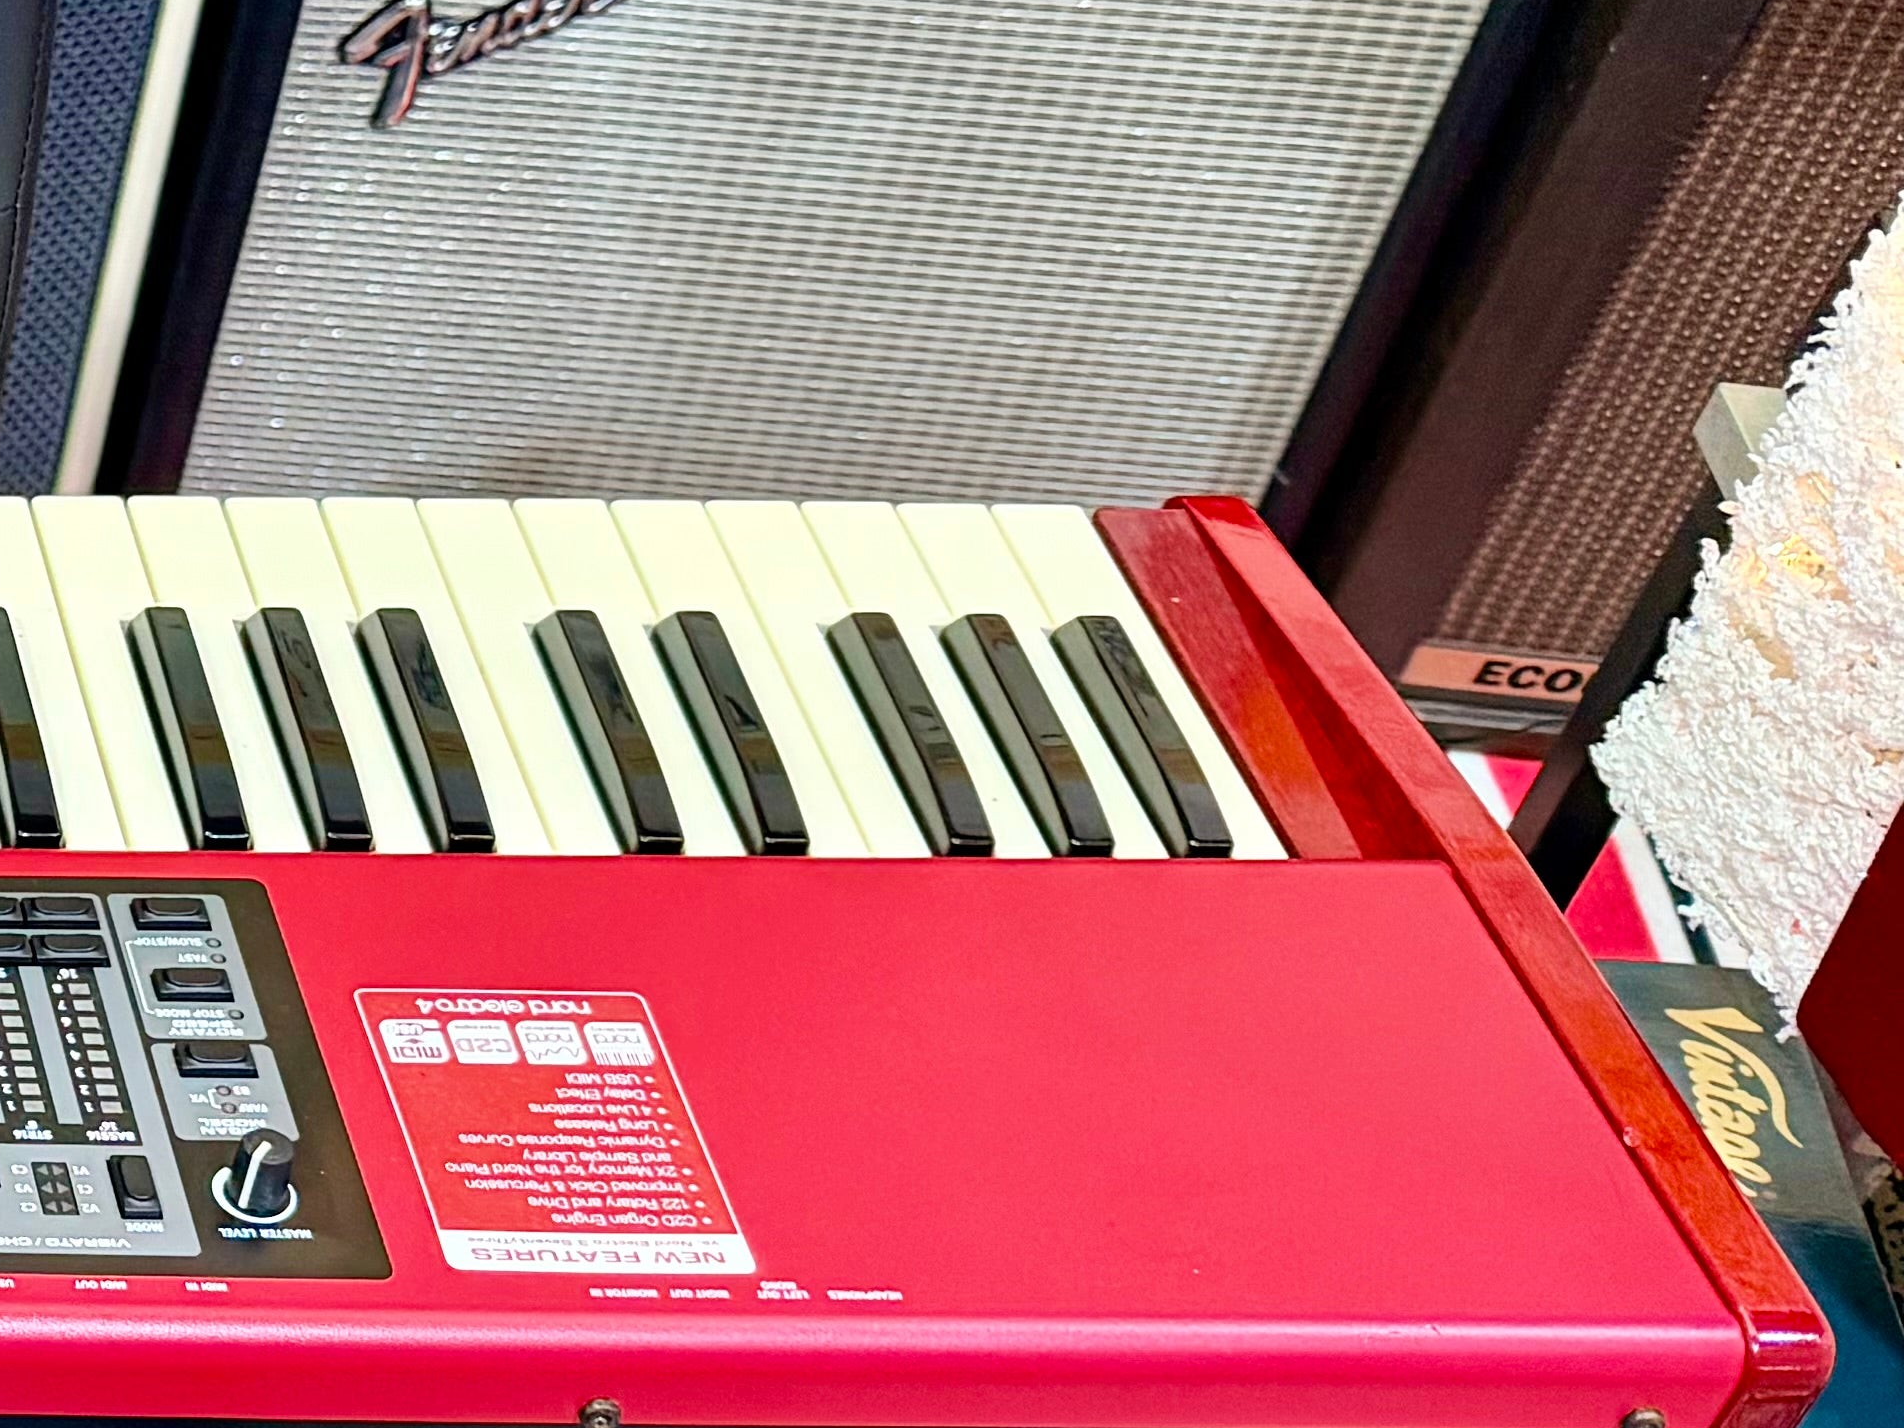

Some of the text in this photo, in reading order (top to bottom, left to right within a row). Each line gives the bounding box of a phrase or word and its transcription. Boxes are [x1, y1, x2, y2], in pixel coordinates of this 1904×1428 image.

[1473, 661, 1583, 692] ECO
[218, 1227, 312, 1240] MASTER LEVEL
[470, 1248, 726, 1264] NEW FEATURES
